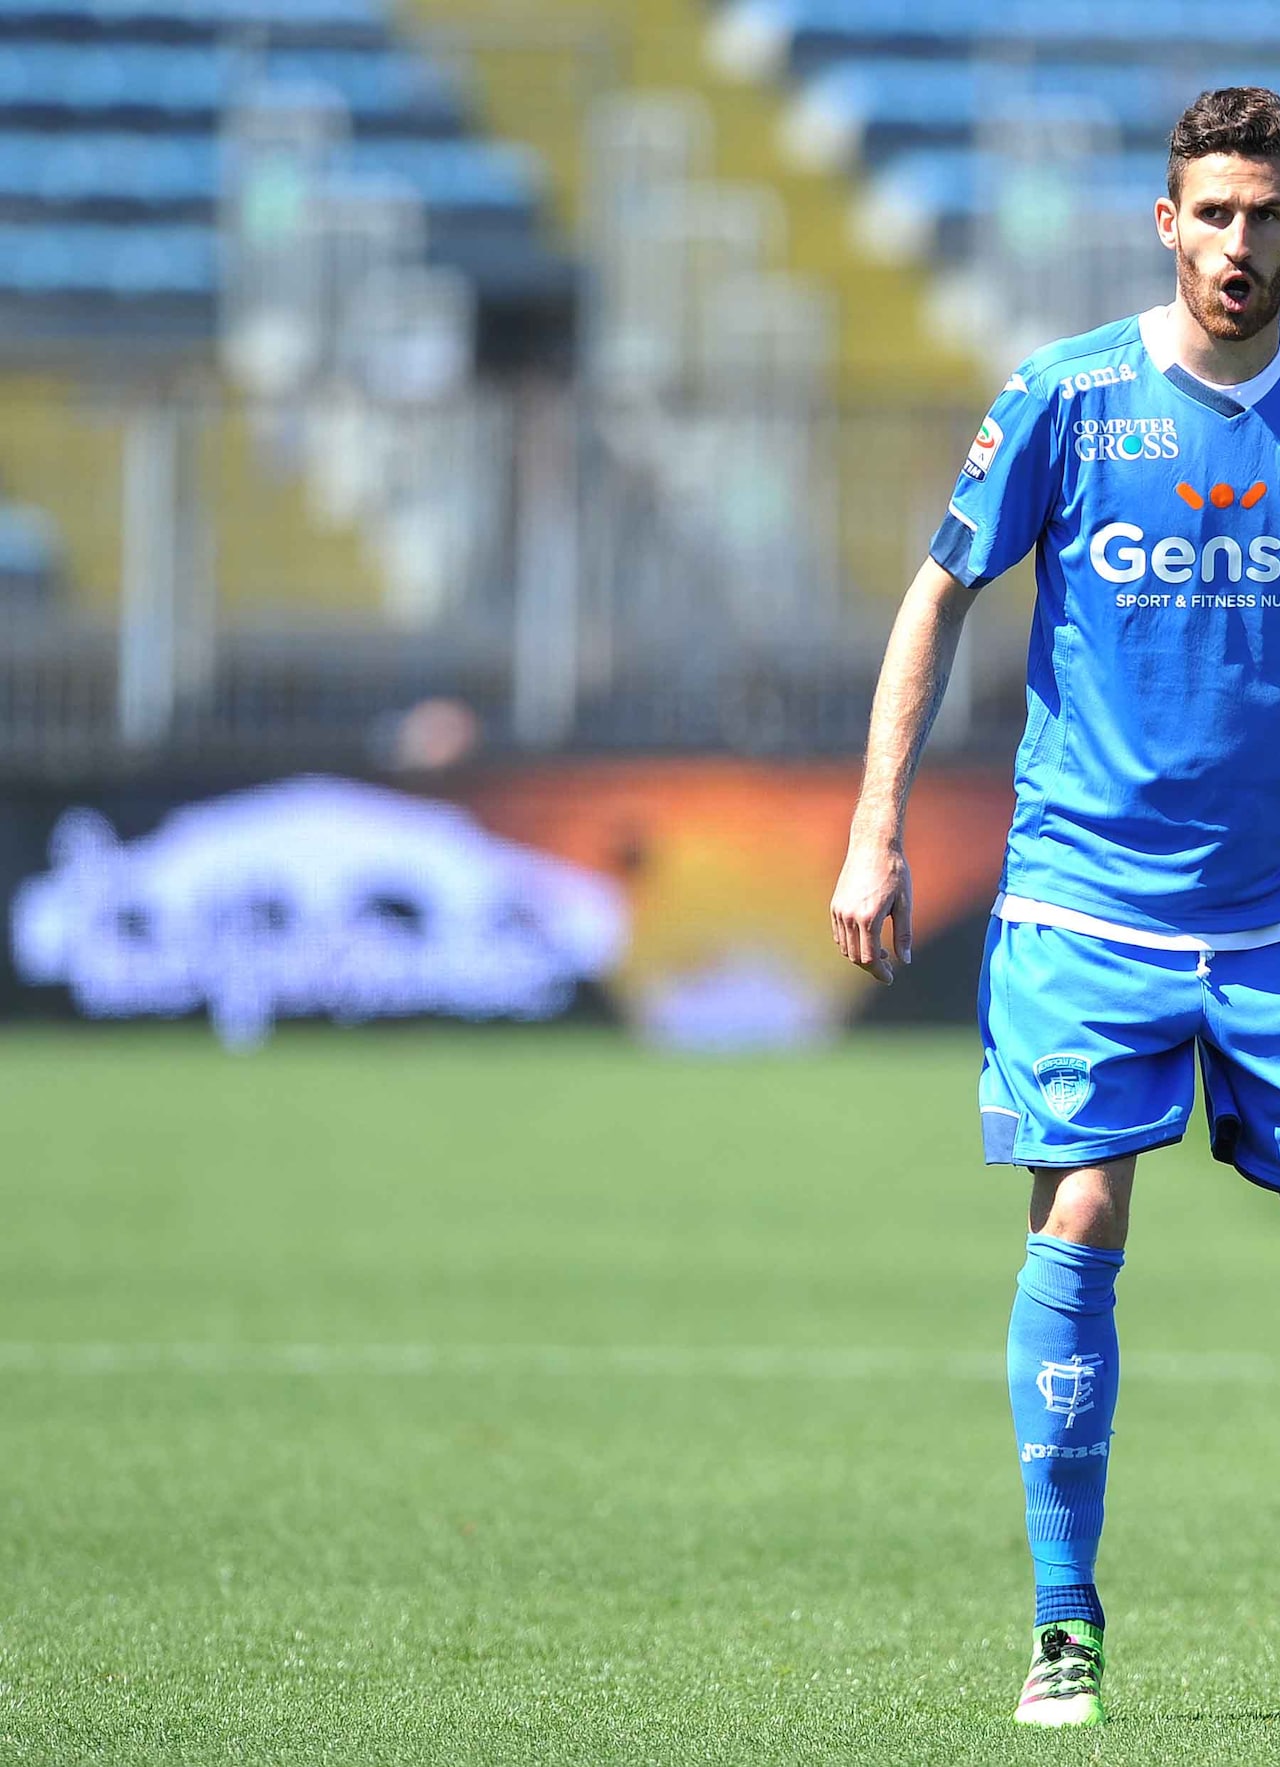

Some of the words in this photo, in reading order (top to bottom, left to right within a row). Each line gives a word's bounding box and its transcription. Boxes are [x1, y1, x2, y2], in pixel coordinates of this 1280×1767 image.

[1073, 418, 1176, 435] COMPUTER
[1074, 432, 1179, 461] GROSS
[1115, 594, 1171, 608] SPORT
[1176, 594, 1187, 608] &
[1191, 594, 1256, 608] FITNESS
